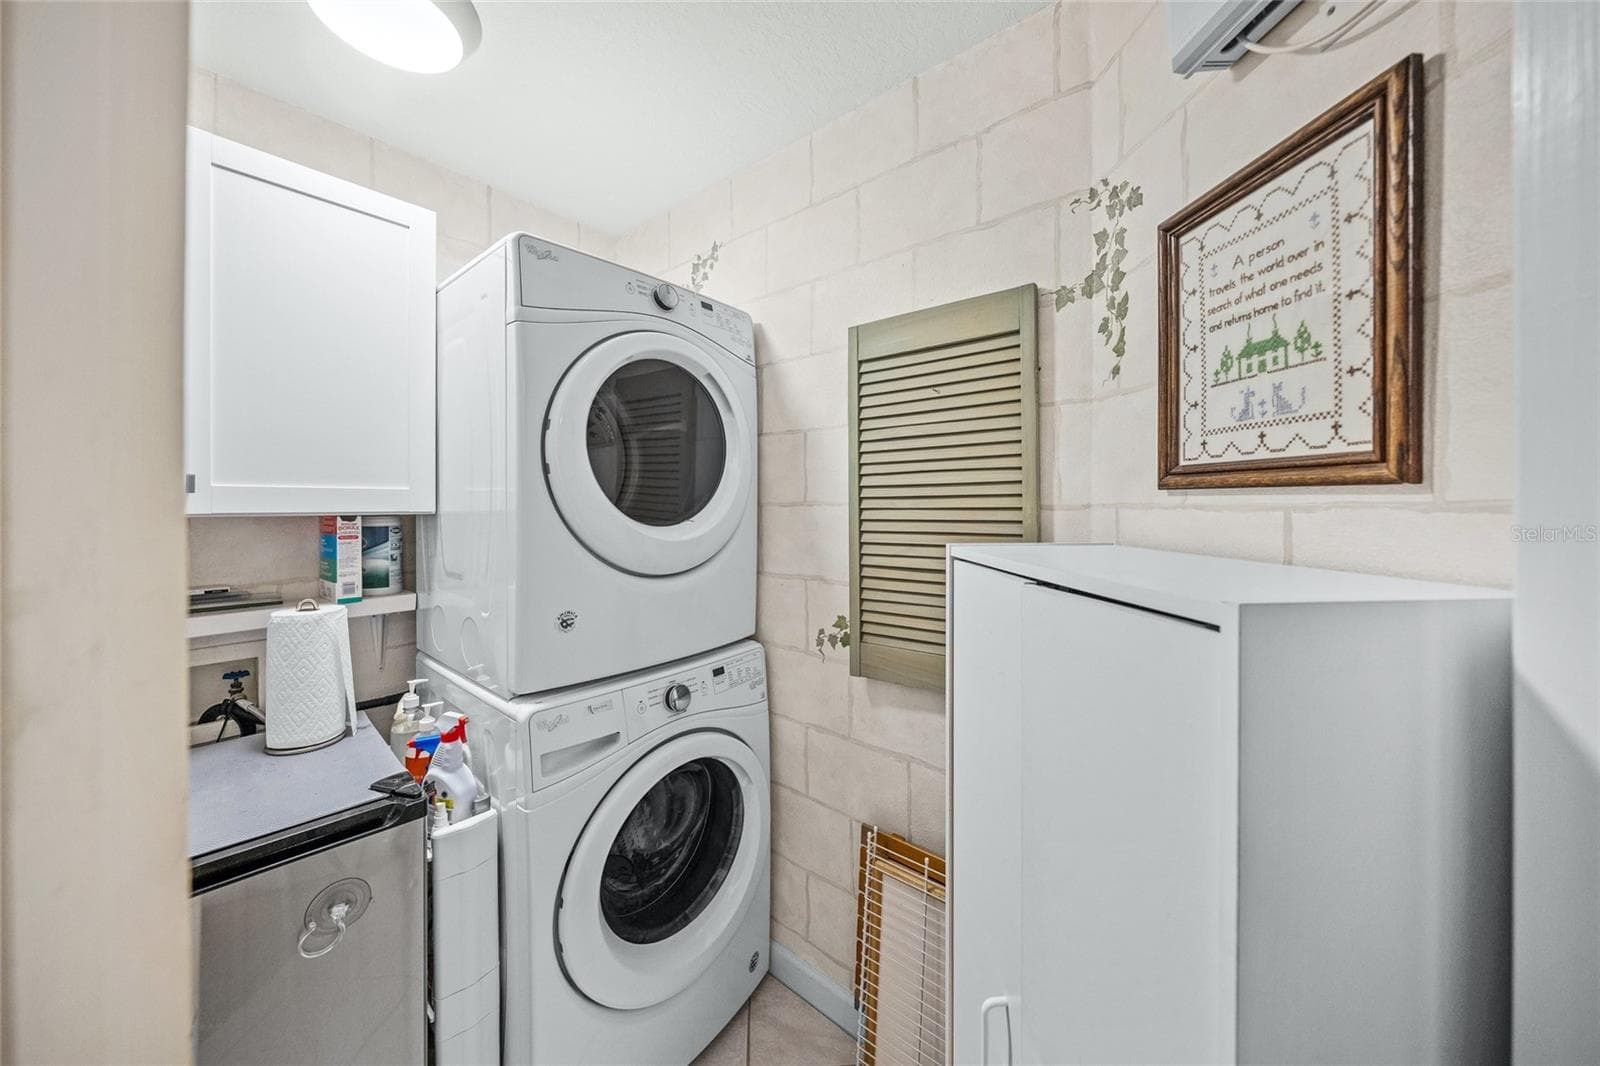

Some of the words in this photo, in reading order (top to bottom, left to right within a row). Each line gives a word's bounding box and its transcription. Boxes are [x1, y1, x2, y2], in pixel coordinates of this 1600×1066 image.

[1209, 279, 1236, 297] travels
[1240, 273, 1254, 285] the
[1257, 256, 1285, 276] world
[1287, 247, 1310, 263] over
[1313, 240, 1325, 252] in
[1232, 255, 1244, 270] A
[1248, 239, 1285, 266] person
[1207, 300, 1232, 316] search
[1234, 292, 1243, 305] of
[1245, 283, 1266, 301] what
[1269, 279, 1288, 291] one
[1290, 261, 1324, 282] needs
[1209, 320, 1223, 333] and
[1224, 313, 1252, 328] returns
[1253, 302, 1279, 318] home
[1281, 296, 1292, 307] to
[1294, 284, 1313, 303] find
[1315, 281, 1326, 293] it.
